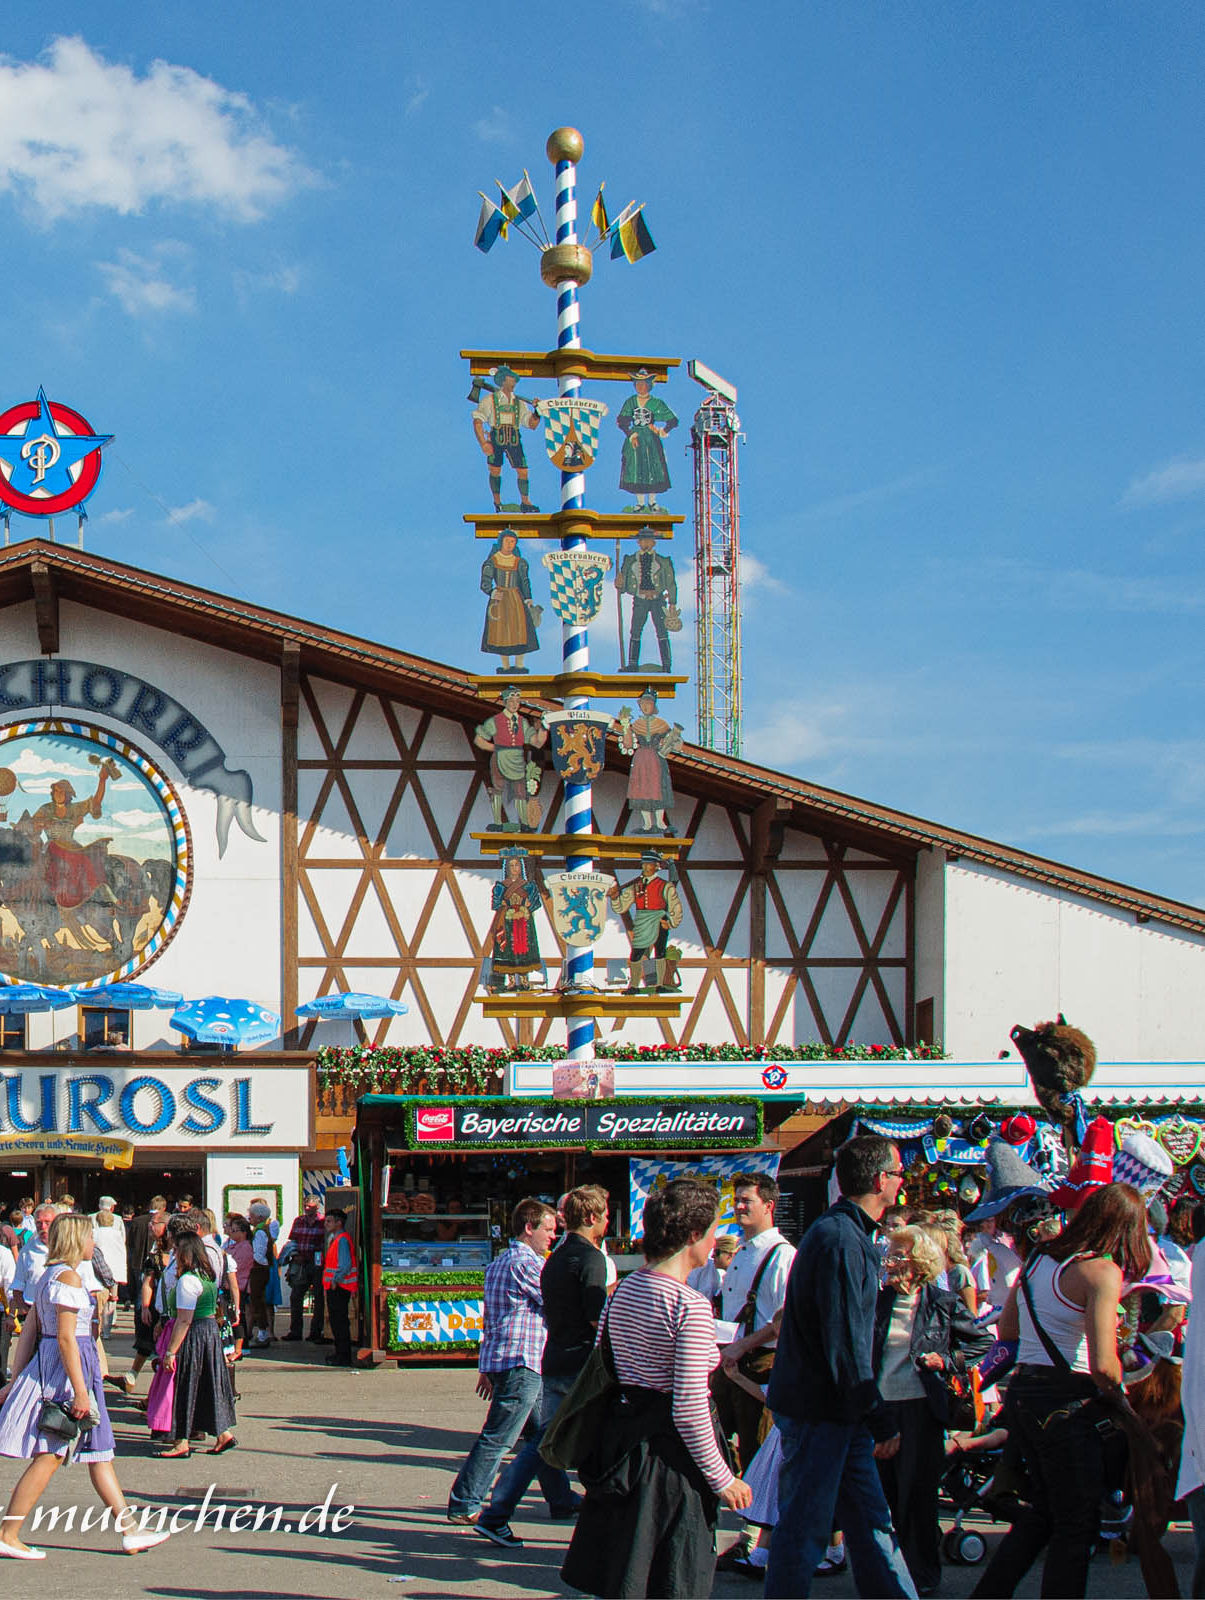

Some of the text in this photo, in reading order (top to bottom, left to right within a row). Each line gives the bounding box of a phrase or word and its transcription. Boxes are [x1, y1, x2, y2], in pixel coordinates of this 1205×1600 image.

[460, 1110, 745, 1139] Bayerische Spezialitäten
[46, 1139, 63, 1149] und
